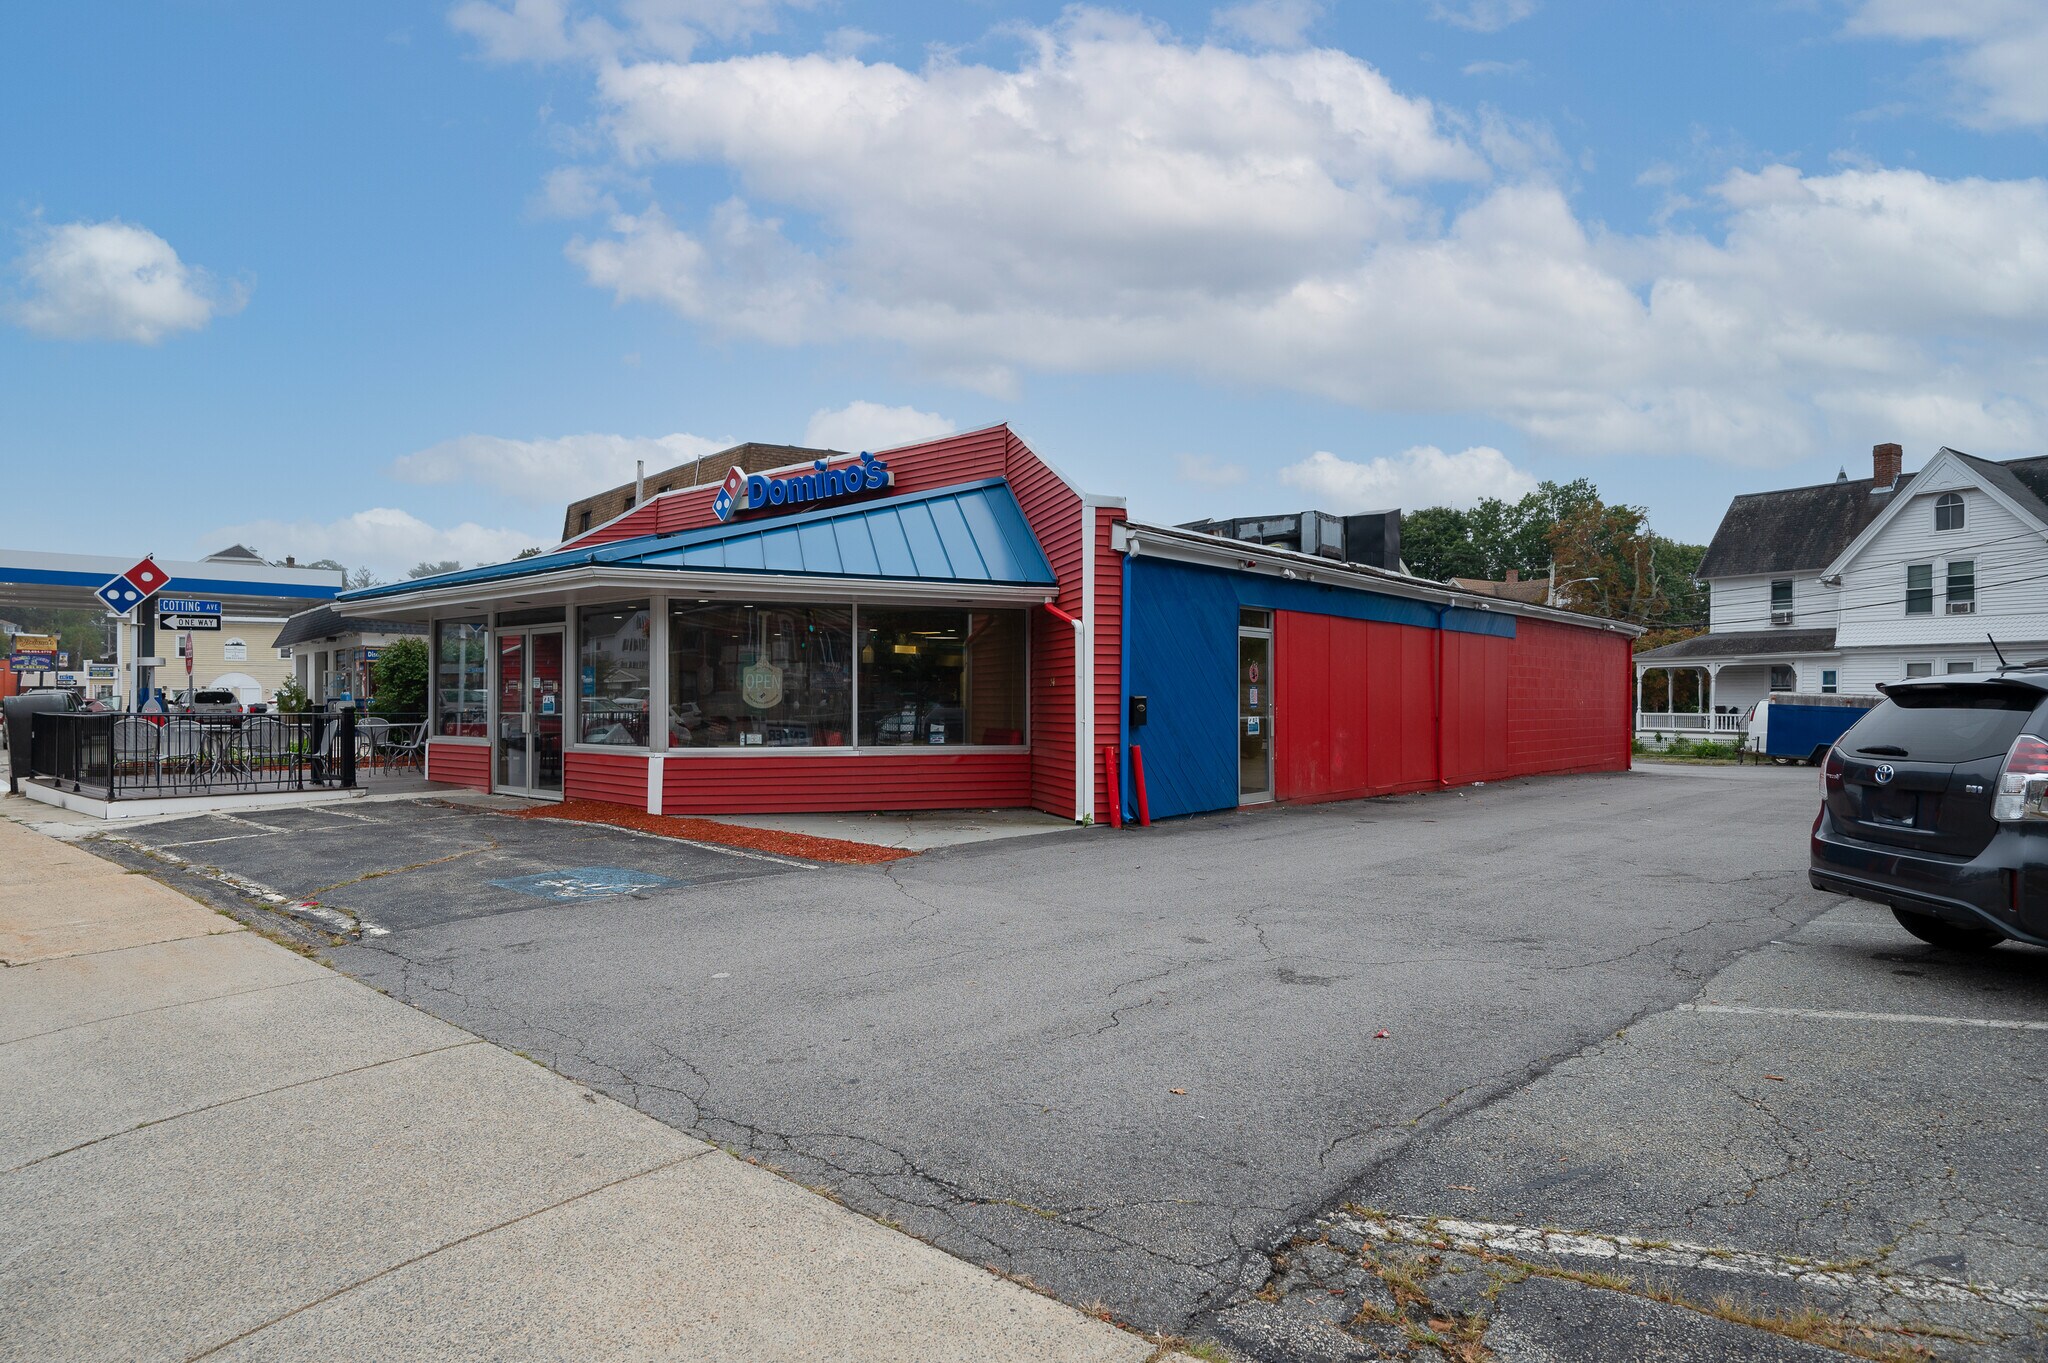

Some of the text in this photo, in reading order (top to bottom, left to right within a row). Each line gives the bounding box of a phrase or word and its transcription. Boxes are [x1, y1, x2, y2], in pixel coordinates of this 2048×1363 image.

[747, 451, 888, 509] Domino's
[162, 600, 218, 612] COTTING AVE
[745, 673, 781, 690] OPEN
